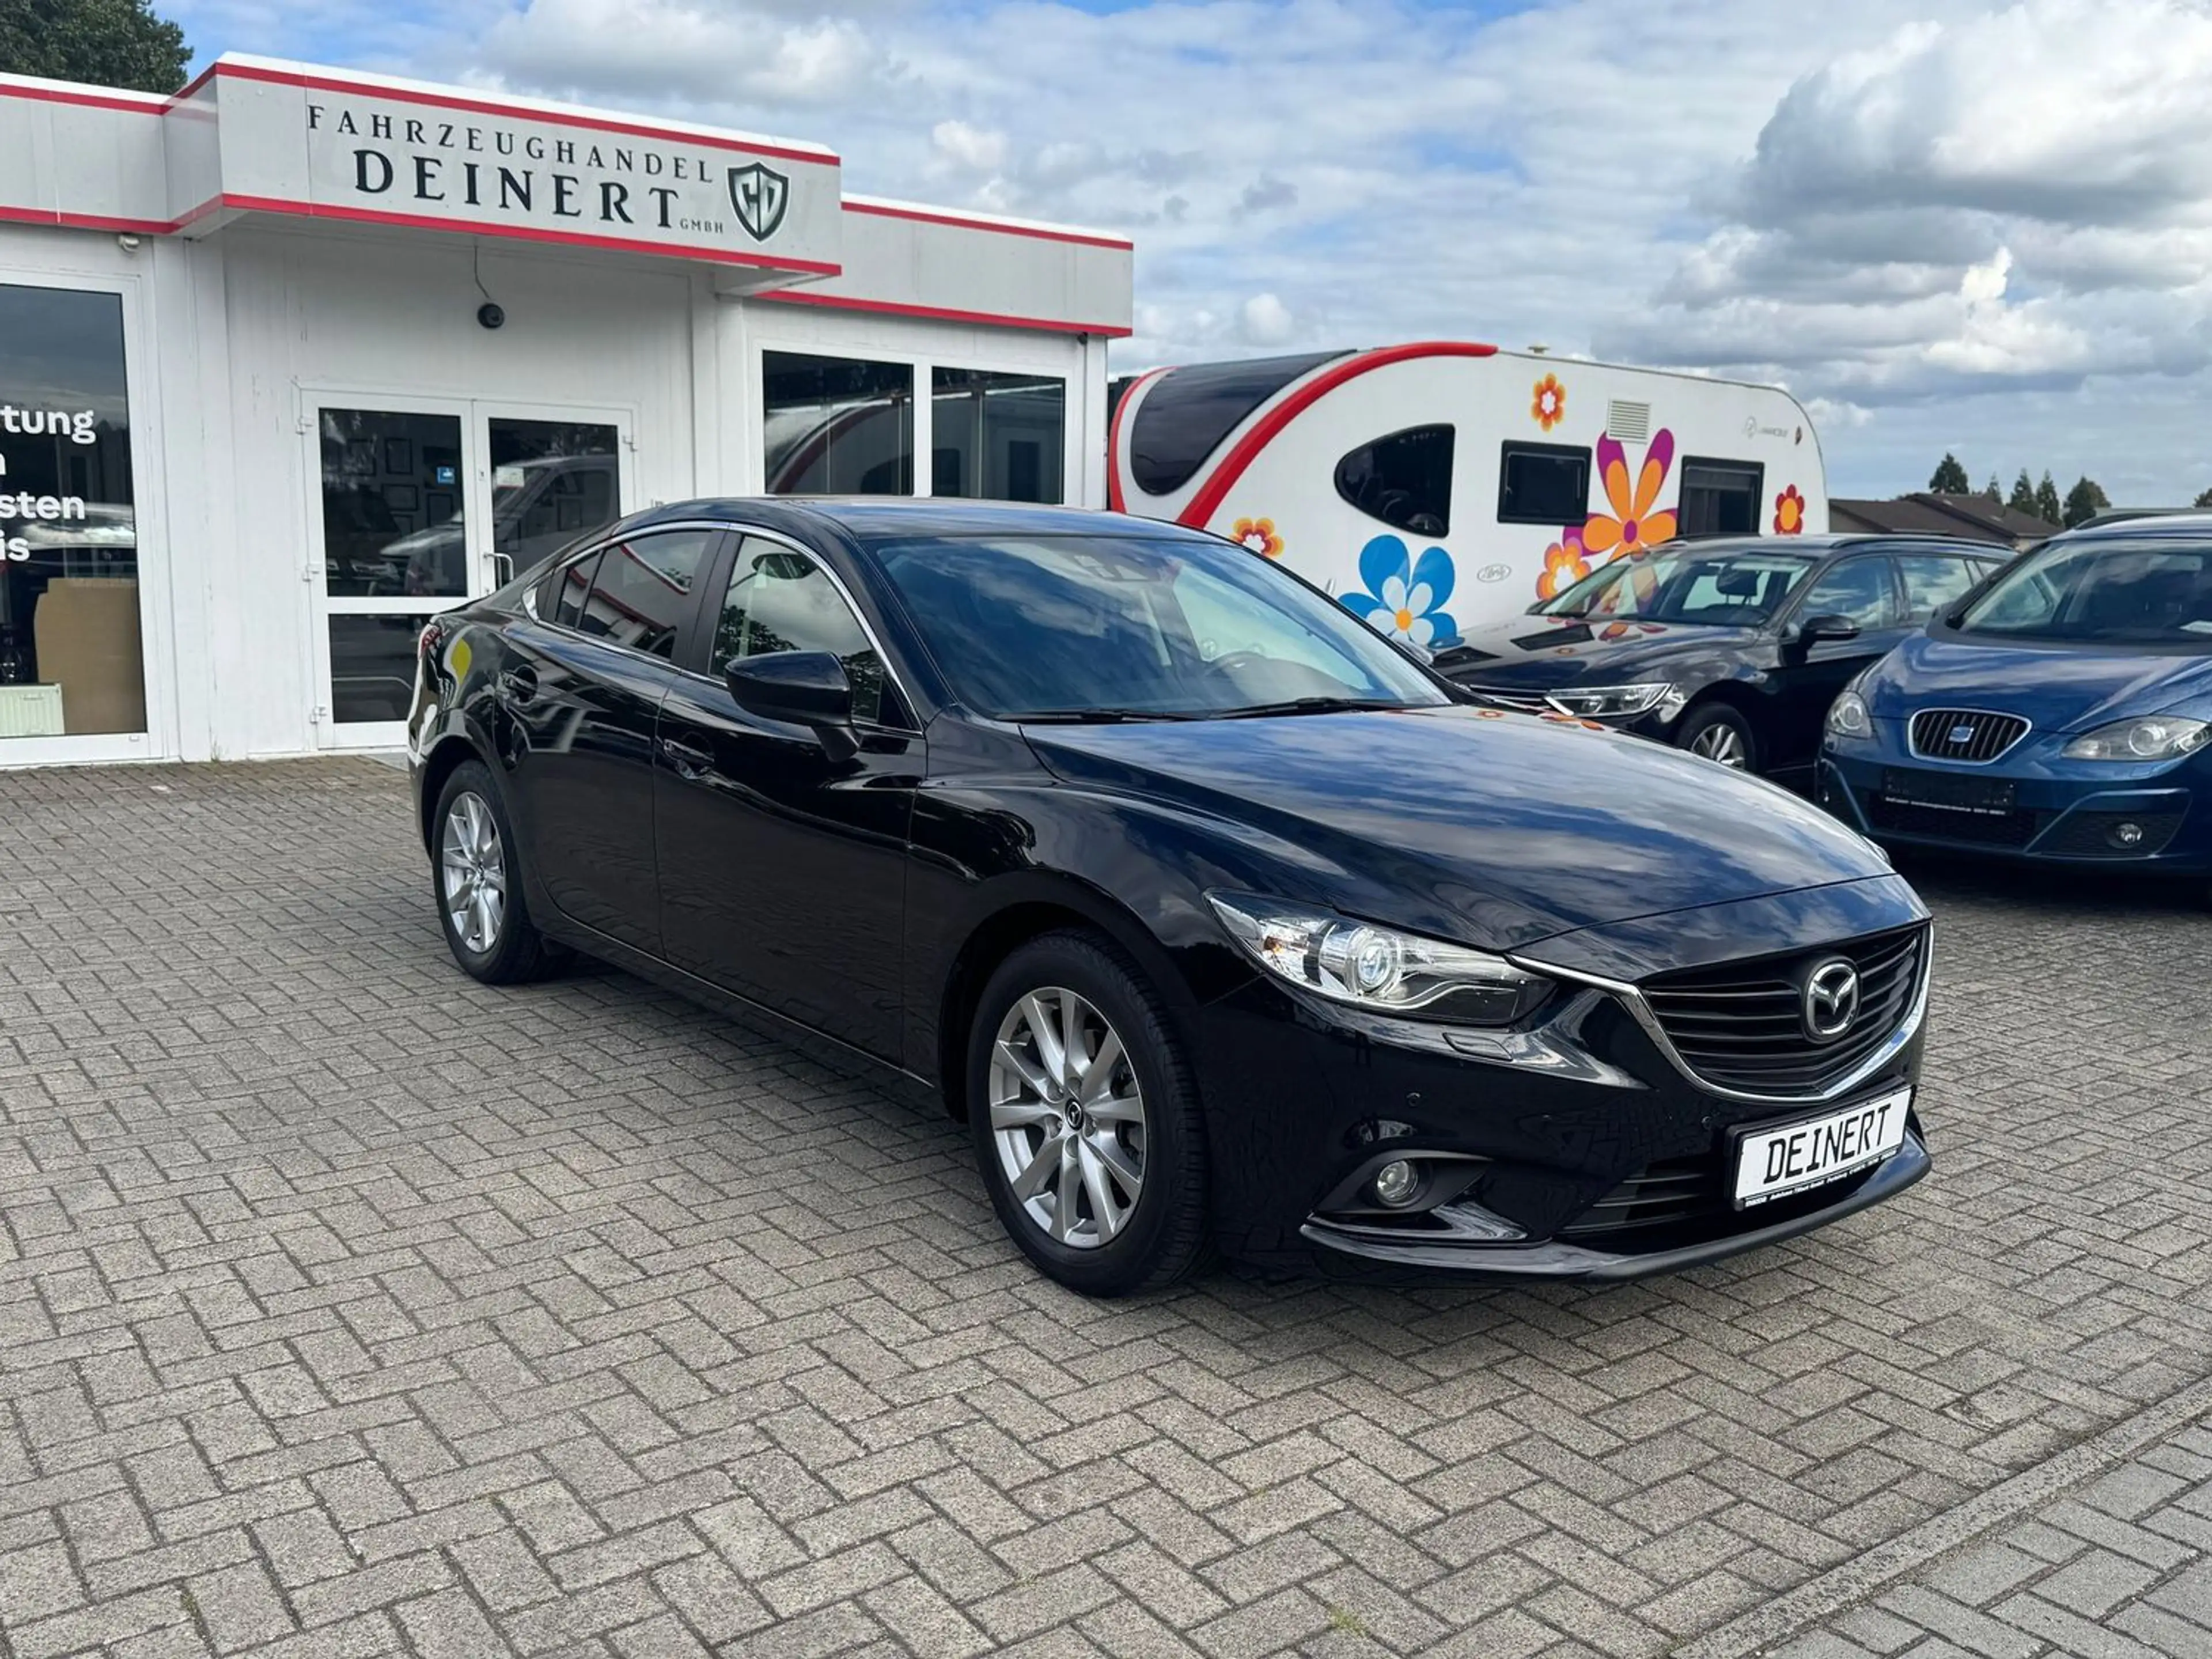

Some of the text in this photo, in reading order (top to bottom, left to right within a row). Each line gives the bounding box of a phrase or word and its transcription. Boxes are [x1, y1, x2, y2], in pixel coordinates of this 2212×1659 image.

[308, 105, 713, 183] FAHRZEUGHANDEL
[354, 149, 723, 234] DEINERT GMBH
[0, 406, 96, 444] tung
[0, 491, 85, 520] sten
[1764, 1104, 1891, 1184] DEINERT
